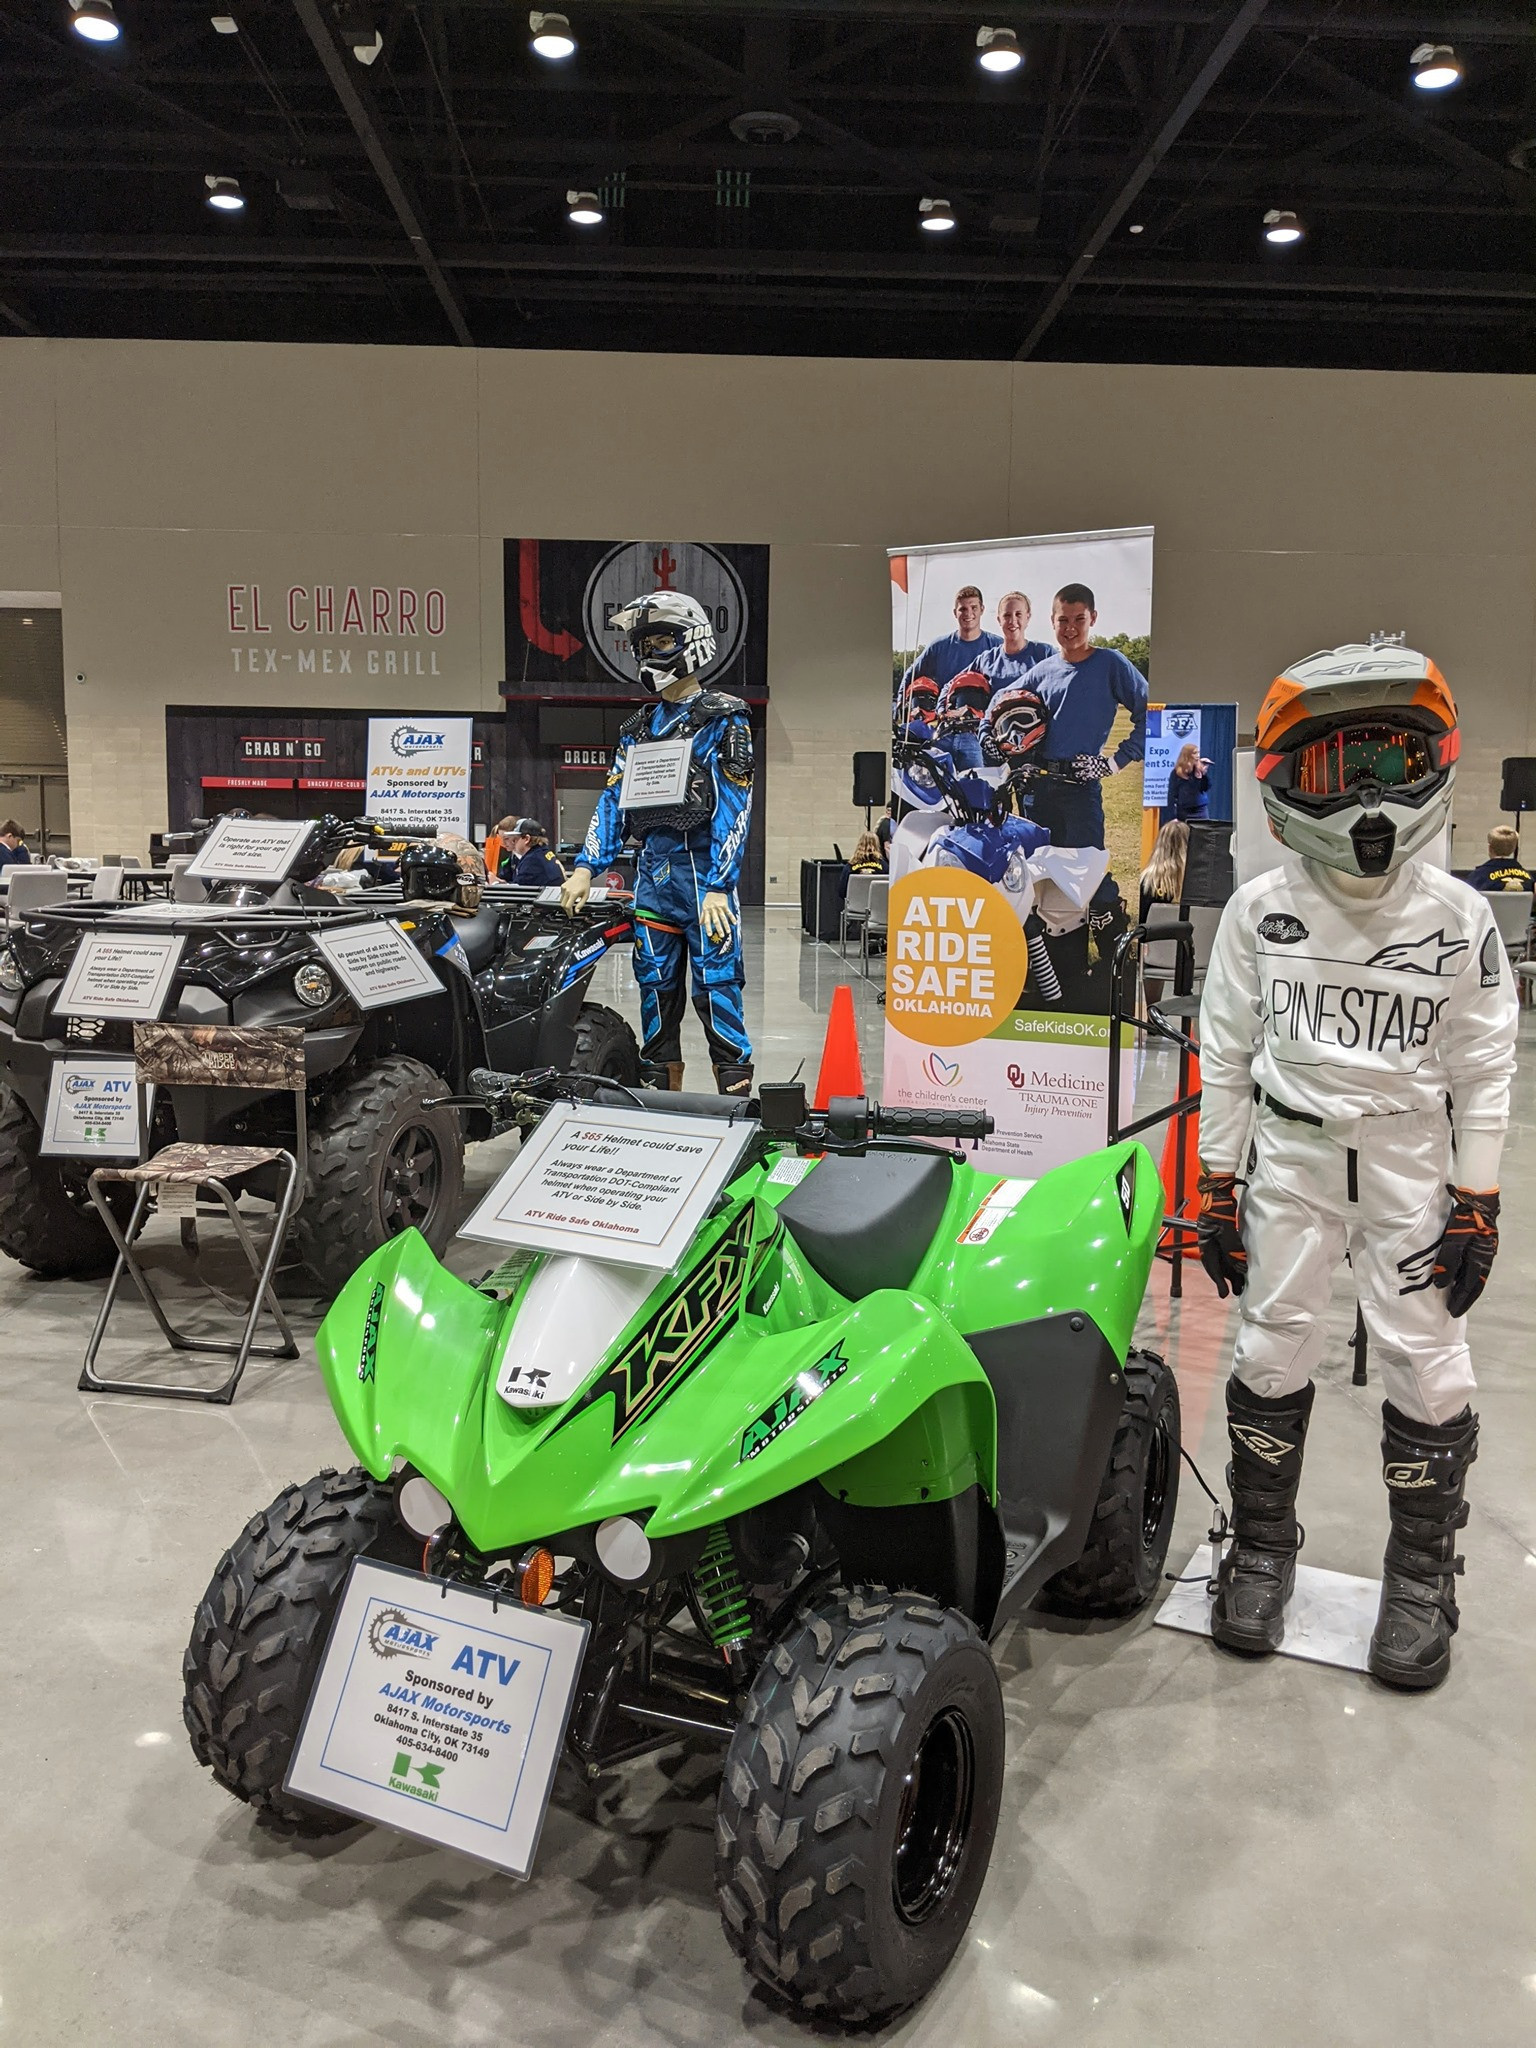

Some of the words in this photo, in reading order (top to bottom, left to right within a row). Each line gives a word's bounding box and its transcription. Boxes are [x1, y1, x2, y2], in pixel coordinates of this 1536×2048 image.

[228, 584, 271, 633] EL
[287, 586, 446, 637] CHARRO
[231, 648, 351, 673] TEX-MEX
[367, 650, 440, 675] GRILL
[1167, 717, 1198, 730] FFA
[403, 735, 446, 744] AJAX
[245, 742, 280, 756] GRAB
[305, 743, 321, 756] GO
[564, 750, 605, 764] ORDER
[1149, 747, 1169, 756] Expo
[371, 767, 403, 776] ATVs
[407, 767, 430, 775] and
[433, 767, 466, 776] UTVs
[370, 790, 400, 798] AJAX
[402, 790, 465, 800] Motorsports
[223, 836, 249, 844] Operate
[1490, 868, 1531, 880] OKLAHOMA
[903, 896, 985, 929] ATV
[345, 949, 364, 958] percent
[896, 930, 992, 965] RIDE
[349, 964, 368, 972] happen
[377, 958, 392, 967] public
[393, 955, 407, 963] roads
[360, 955, 367, 963] by
[368, 953, 379, 961] Side
[380, 950, 399, 958] crashes
[376, 965, 400, 974] highways.
[892, 965, 995, 1000] SAFE
[893, 997, 993, 1018] OKLAHOMA
[202, 1052, 234, 1062] TIMBER
[208, 1060, 236, 1070] RIDGE
[103, 1081, 131, 1092] ATV
[1007, 1064, 1025, 1088] OU
[1031, 1071, 1105, 1092] Medicine
[898, 1089, 912, 1098] the
[915, 1090, 956, 1102] children's
[958, 1097, 988, 1105] center
[1019, 1092, 1069, 1106] TRAUMA
[1072, 1098, 1098, 1108] ONE
[1024, 1104, 1049, 1117] Injury
[1051, 1106, 1092, 1119] Prevention
[996, 1129, 1023, 1137] Prevention
[562, 1143, 589, 1151] your
[590, 1145, 620, 1155] Life!!
[582, 1132, 603, 1140] $65
[602, 1134, 642, 1146] Helmet
[643, 1141, 676, 1150] could
[676, 1145, 703, 1154] save
[981, 1145, 1010, 1153] Department
[551, 1160, 583, 1170] Always
[615, 1168, 669, 1181] Department
[543, 1169, 607, 1183] Transportation
[608, 1177, 679, 1193] DOT-Compliant
[541, 1179, 573, 1188] helmet
[573, 1184, 597, 1192] when
[599, 1188, 643, 1200] operating
[643, 1194, 667, 1202] your
[584, 1195, 605, 1204] Side
[606, 1199, 619, 1207] by
[620, 1201, 642, 1210] Side.
[546, 1213, 567, 1221] Ride
[569, 1217, 590, 1225] Safe
[592, 1220, 639, 1233] Oklahoma
[610, 1207, 756, 1411] KFX
[363, 1282, 385, 1383] AJAX
[384, 1624, 440, 1652] AJAX
[451, 1644, 521, 1686] ATV
[405, 1669, 474, 1701] Sponsored
[477, 1692, 494, 1709] by
[379, 1683, 421, 1705] AJAX
[421, 1695, 512, 1735] Motorsports
[387, 1703, 410, 1717] 8417
[411, 1711, 420, 1722] S.
[422, 1714, 468, 1737] Interstate
[471, 1731, 483, 1742] 35
[374, 1713, 418, 1735] Oklahoma
[421, 1729, 440, 1744] City,
[444, 1737, 460, 1749] OK
[461, 1743, 490, 1758] 73149
[396, 1734, 458, 1762] 405-634-8400
[388, 1776, 439, 1802] Kawasaki
